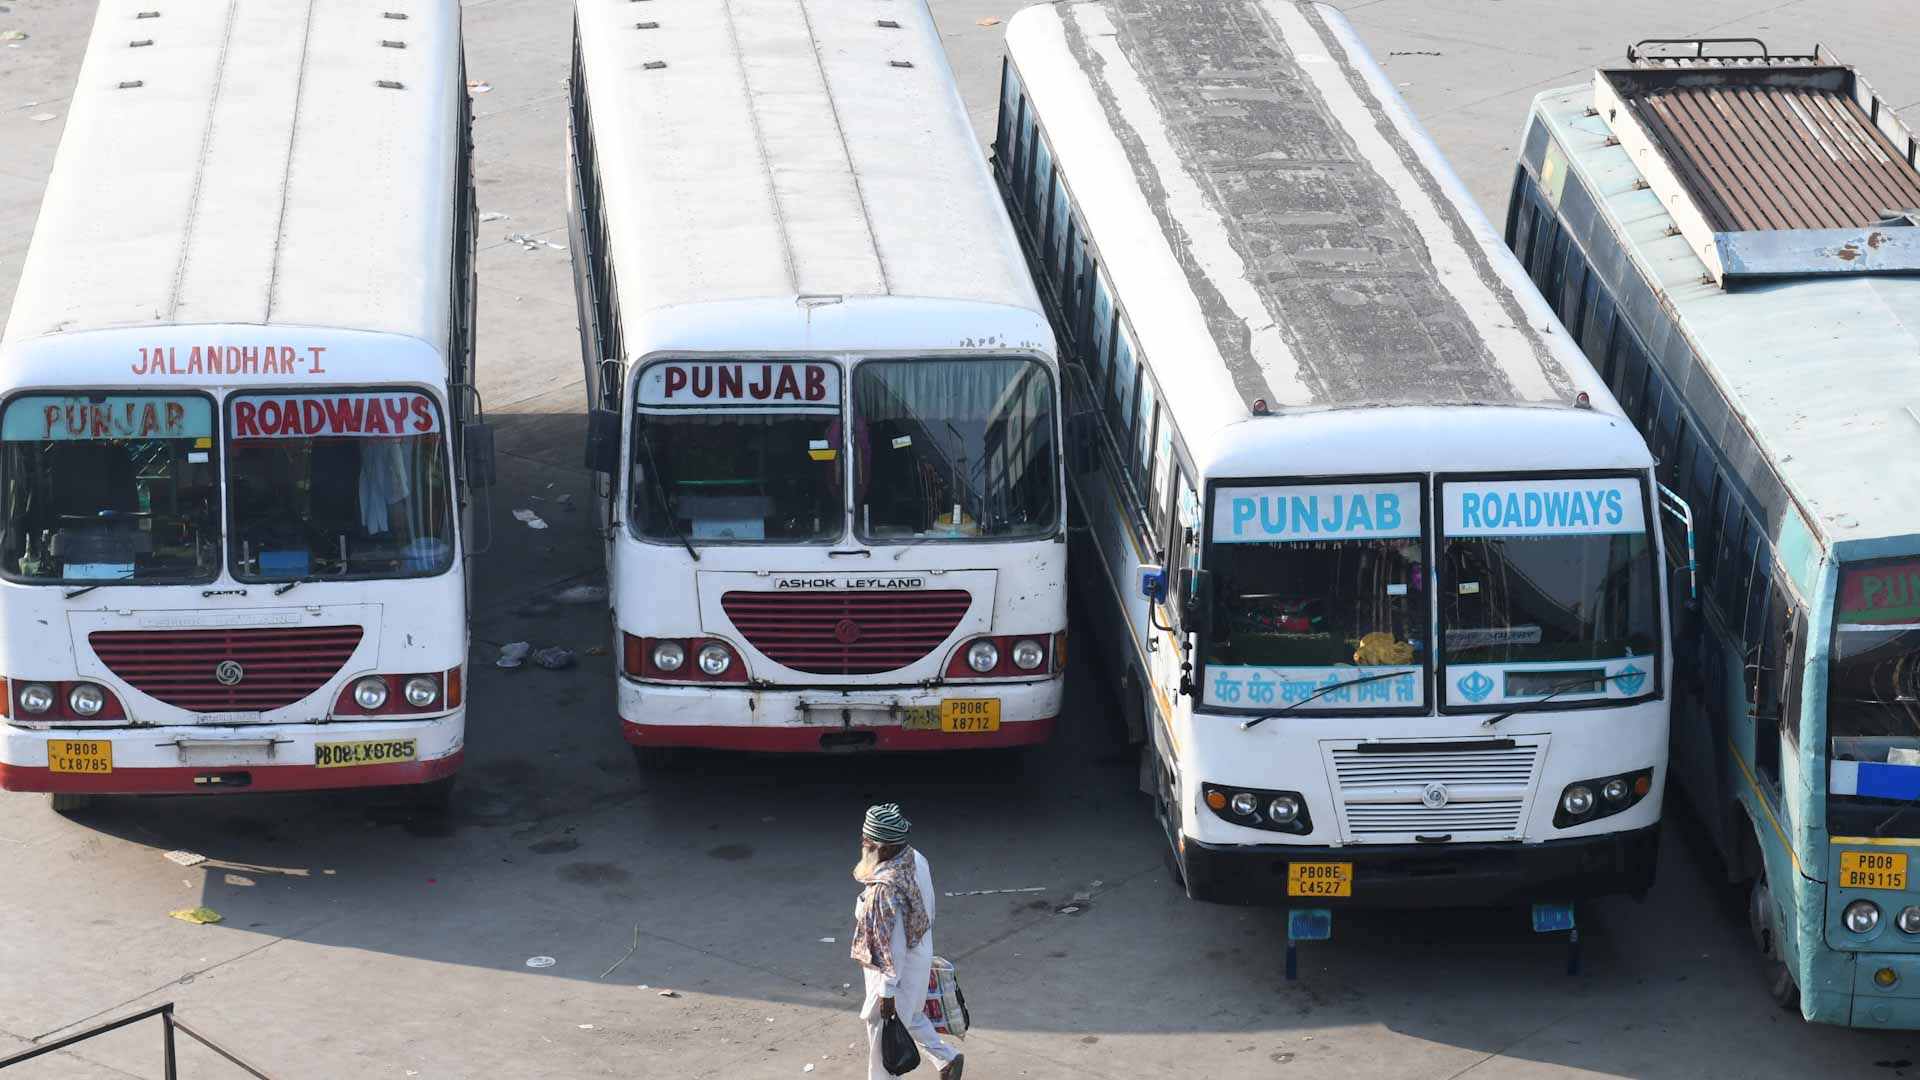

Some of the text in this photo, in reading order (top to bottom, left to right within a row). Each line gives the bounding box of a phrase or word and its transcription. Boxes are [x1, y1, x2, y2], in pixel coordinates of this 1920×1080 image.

[132, 346, 326, 375] JALANDHAR-I
[664, 364, 826, 401] PUNJAB
[236, 398, 434, 436] ROADWAYS
[1232, 489, 1623, 536] PUNJAB ROADWAYS
[778, 578, 922, 589] ASHOK LEYLAND
[951, 701, 990, 714] PB08C
[952, 717, 990, 730] X8712
[66, 743, 98, 756] PB08
[59, 758, 108, 772] CX8785
[1859, 855, 1893, 869] PB08
[1300, 866, 1340, 878] PB08E
[1850, 871, 1902, 887] BR9115
[1300, 881, 1340, 894] C4527
